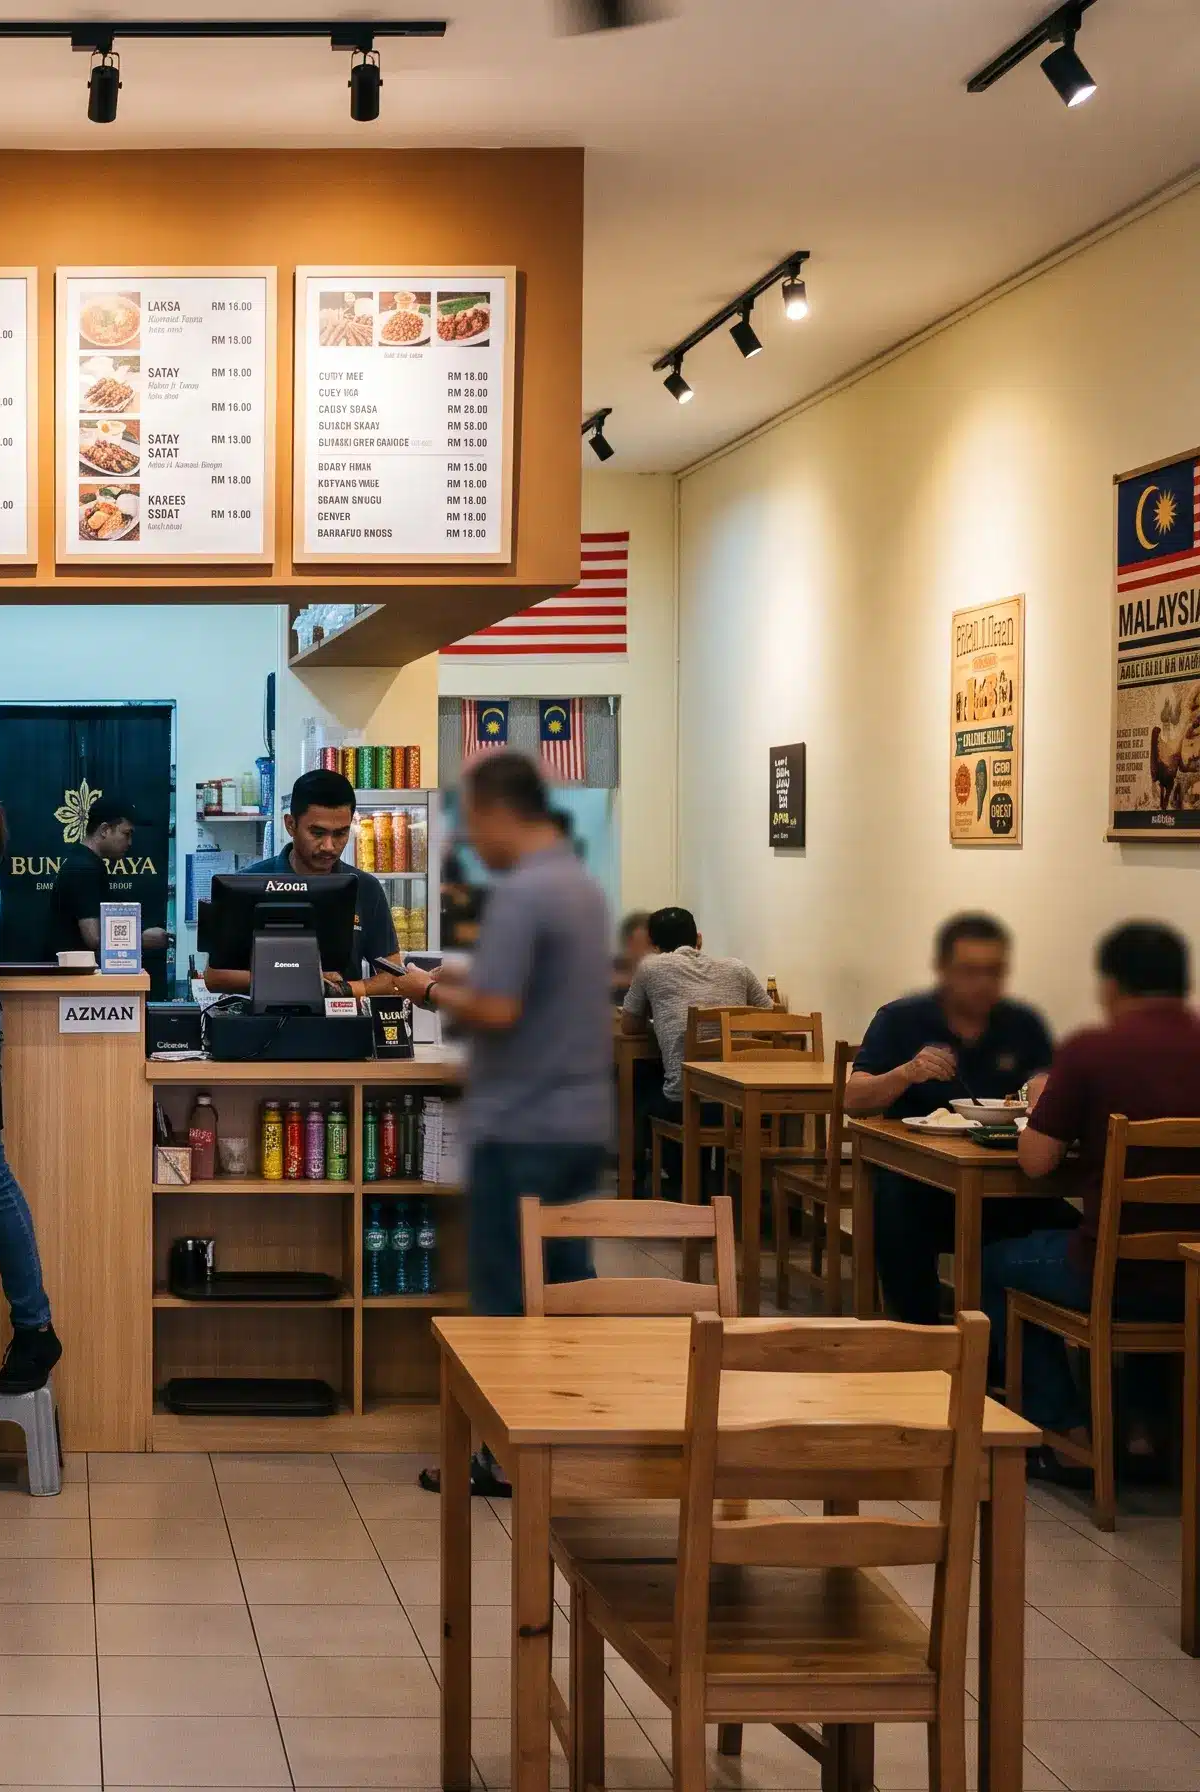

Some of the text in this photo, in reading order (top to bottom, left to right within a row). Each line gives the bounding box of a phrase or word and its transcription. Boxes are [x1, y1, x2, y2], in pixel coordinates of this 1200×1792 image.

[148, 301, 181, 312] LAKSA
[211, 302, 226, 311] RM
[211, 335, 226, 345] RM
[148, 367, 180, 378] SATAY
[211, 368, 226, 378] RM
[346, 371, 364, 381] MEE
[447, 371, 461, 381] RM
[463, 371, 488, 381] 18.00
[447, 388, 461, 398] RM
[211, 402, 226, 412] RM
[447, 405, 461, 414] RM
[447, 421, 461, 431] RM
[148, 434, 179, 444] SATAY
[211, 435, 225, 444] RM
[447, 438, 461, 447] RM
[148, 448, 179, 458] SATAT
[447, 463, 461, 472] RM
[211, 475, 225, 484] RM
[447, 479, 460, 488] RM
[447, 496, 460, 505] RM
[211, 510, 225, 519] RM
[446, 512, 460, 521] RM
[446, 529, 460, 538] RM
[65, 1007, 135, 1022] AZMAN
